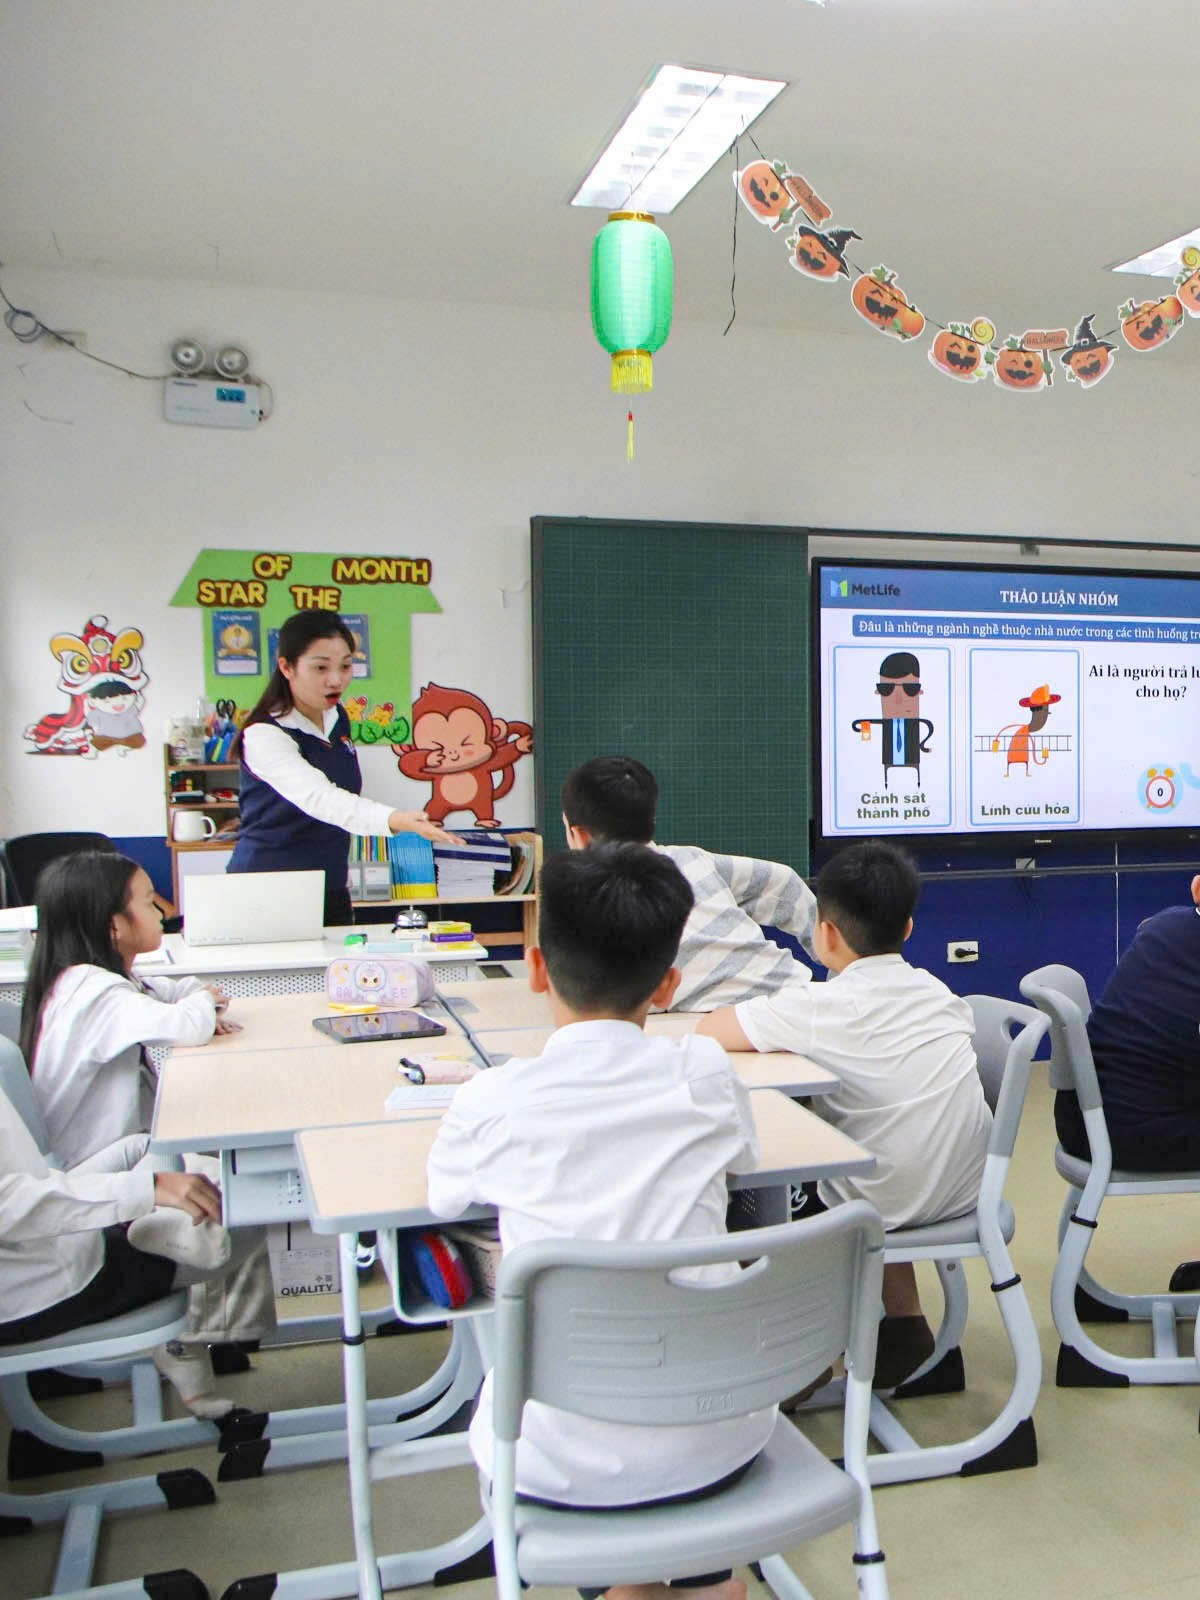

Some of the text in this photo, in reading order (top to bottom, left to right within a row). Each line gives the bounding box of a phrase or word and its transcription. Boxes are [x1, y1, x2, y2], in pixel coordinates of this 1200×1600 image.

[199, 555, 430, 610] STAR OF THE MONTH
[851, 582, 900, 597] MetLife
[1000, 588, 1119, 607] THẢO LUẬN NHÓM
[859, 620, 881, 633] Đâu
[884, 620, 895, 633] là
[897, 621, 934, 637] những
[936, 622, 970, 637] ngành
[972, 622, 999, 638] nghề
[1001, 624, 1031, 637] thuộc
[1034, 624, 1054, 636] nhà
[1056, 624, 1083, 637] nước
[1086, 627, 1114, 639] trong
[1116, 626, 1132, 638] các
[1157, 626, 1188, 641] huống
[1089, 665, 1103, 678] Ai
[1107, 665, 1119, 678] là
[1124, 665, 1164, 681] người
[1168, 665, 1188, 679] trả
[1136, 685, 1187, 701] cho họ?
[1157, 787, 1164, 797] 0
[281, 1284, 333, 1296] QUALITY
